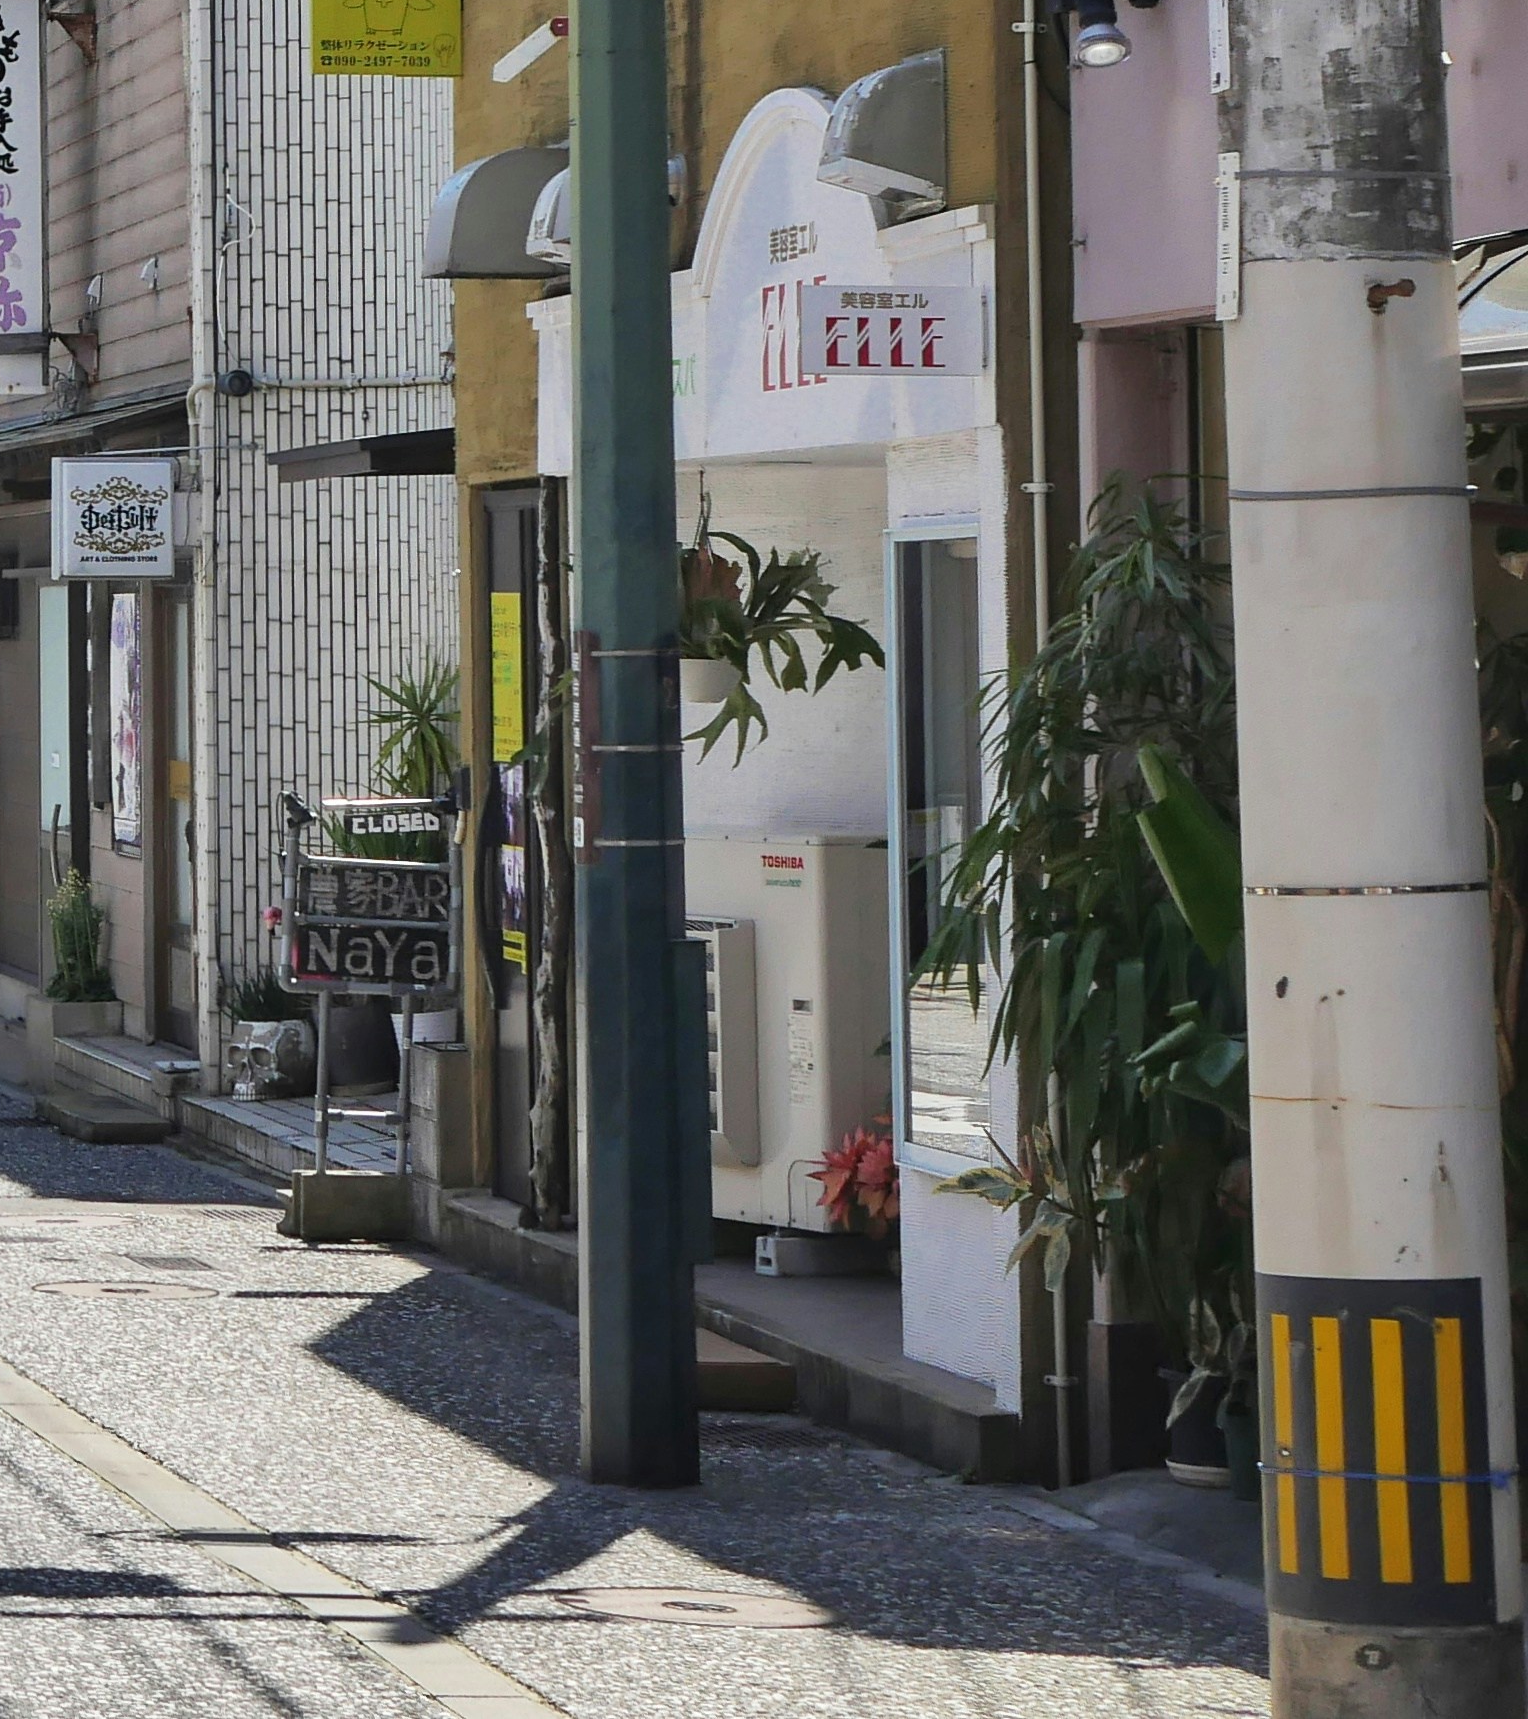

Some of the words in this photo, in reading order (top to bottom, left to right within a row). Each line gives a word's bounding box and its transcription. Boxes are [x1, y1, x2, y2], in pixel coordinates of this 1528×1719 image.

[320, 39, 429, 52] 整体リラクゼーション
[769, 220, 818, 264] 美容室エル
[840, 291, 929, 309] 美容室エル
[825, 316, 946, 367] ELLE
[352, 812, 440, 834] CLOSED
[761, 855, 804, 869] TOSHIBA
[306, 928, 441, 981] NaYa
